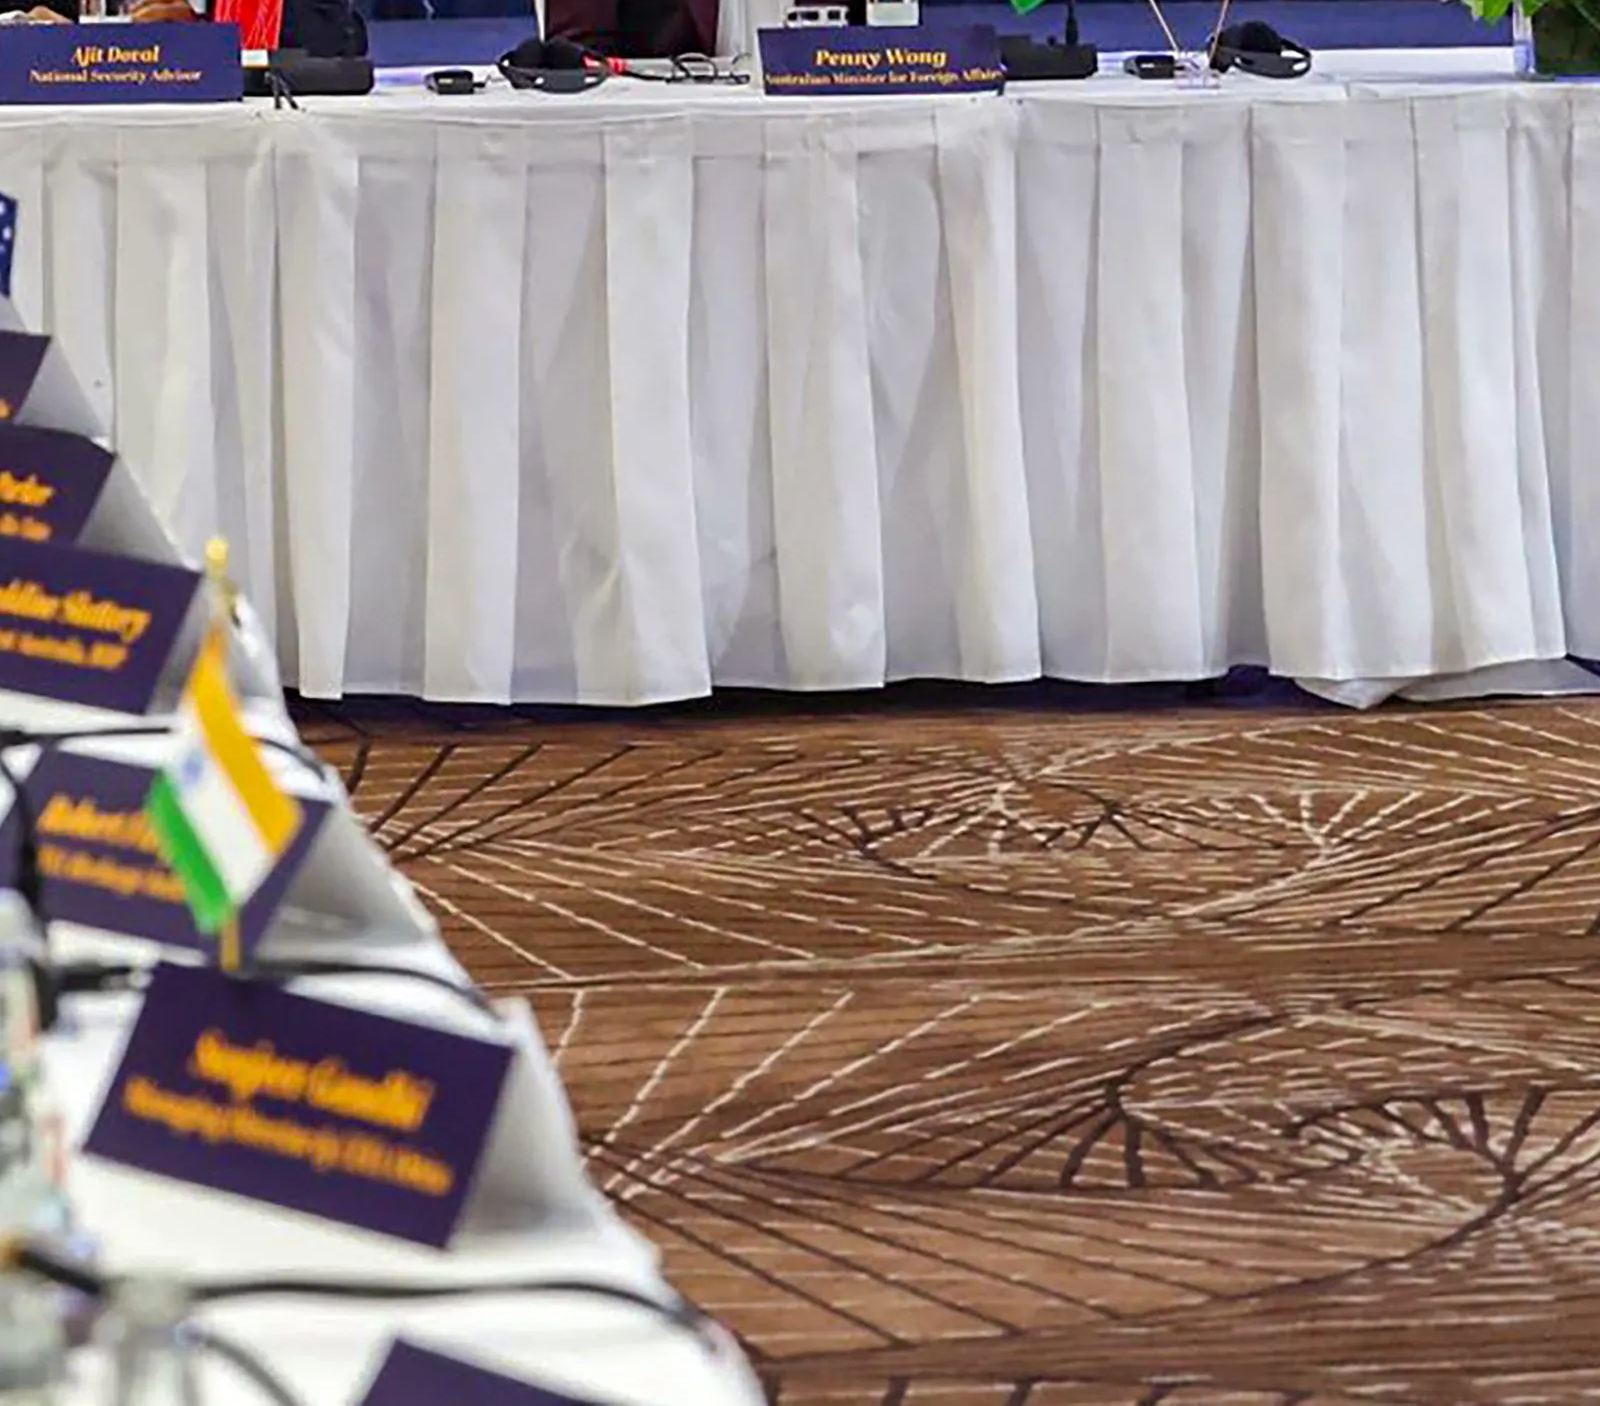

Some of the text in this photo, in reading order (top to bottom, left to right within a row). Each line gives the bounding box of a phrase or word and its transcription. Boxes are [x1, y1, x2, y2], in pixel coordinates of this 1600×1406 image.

[71, 44, 161, 67] Ajit Doval
[816, 47, 948, 70] Penny Wong
[29, 69, 88, 84] National
[91, 69, 146, 85] Security
[832, 72, 886, 86] Minister
